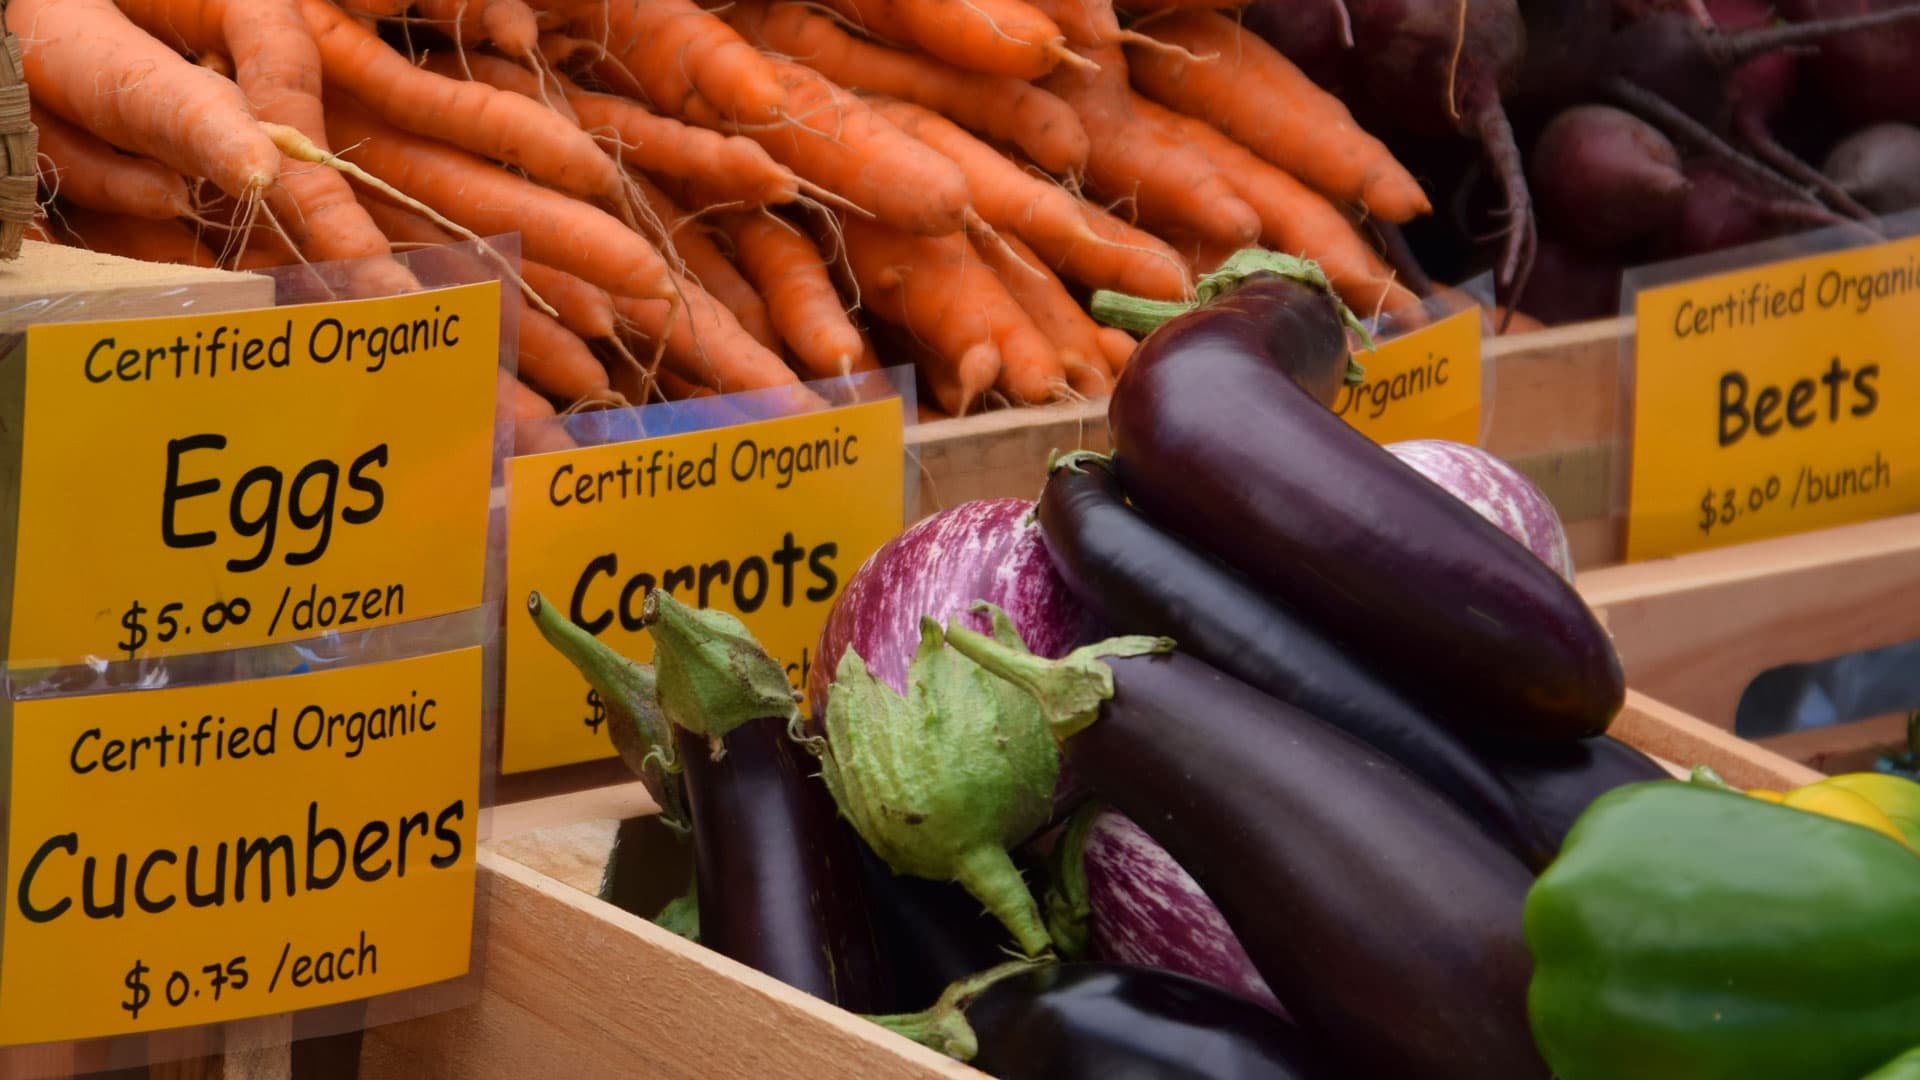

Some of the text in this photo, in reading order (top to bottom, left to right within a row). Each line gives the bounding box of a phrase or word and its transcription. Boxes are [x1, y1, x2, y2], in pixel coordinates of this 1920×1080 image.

[85, 305, 460, 383] Certified Organic
[1674, 275, 1806, 338] Certified
[1717, 356, 1880, 448] Beets
[161, 433, 389, 573] Eggs
[549, 426, 859, 507] Certified Organic
[1790, 450, 1892, 509] /bunch
[268, 583, 404, 637] /dozen
[570, 531, 839, 637] Carrots
[69, 690, 437, 774] Certified Organic
[17, 799, 465, 923] Cucumbers
[268, 930, 378, 993] /each
